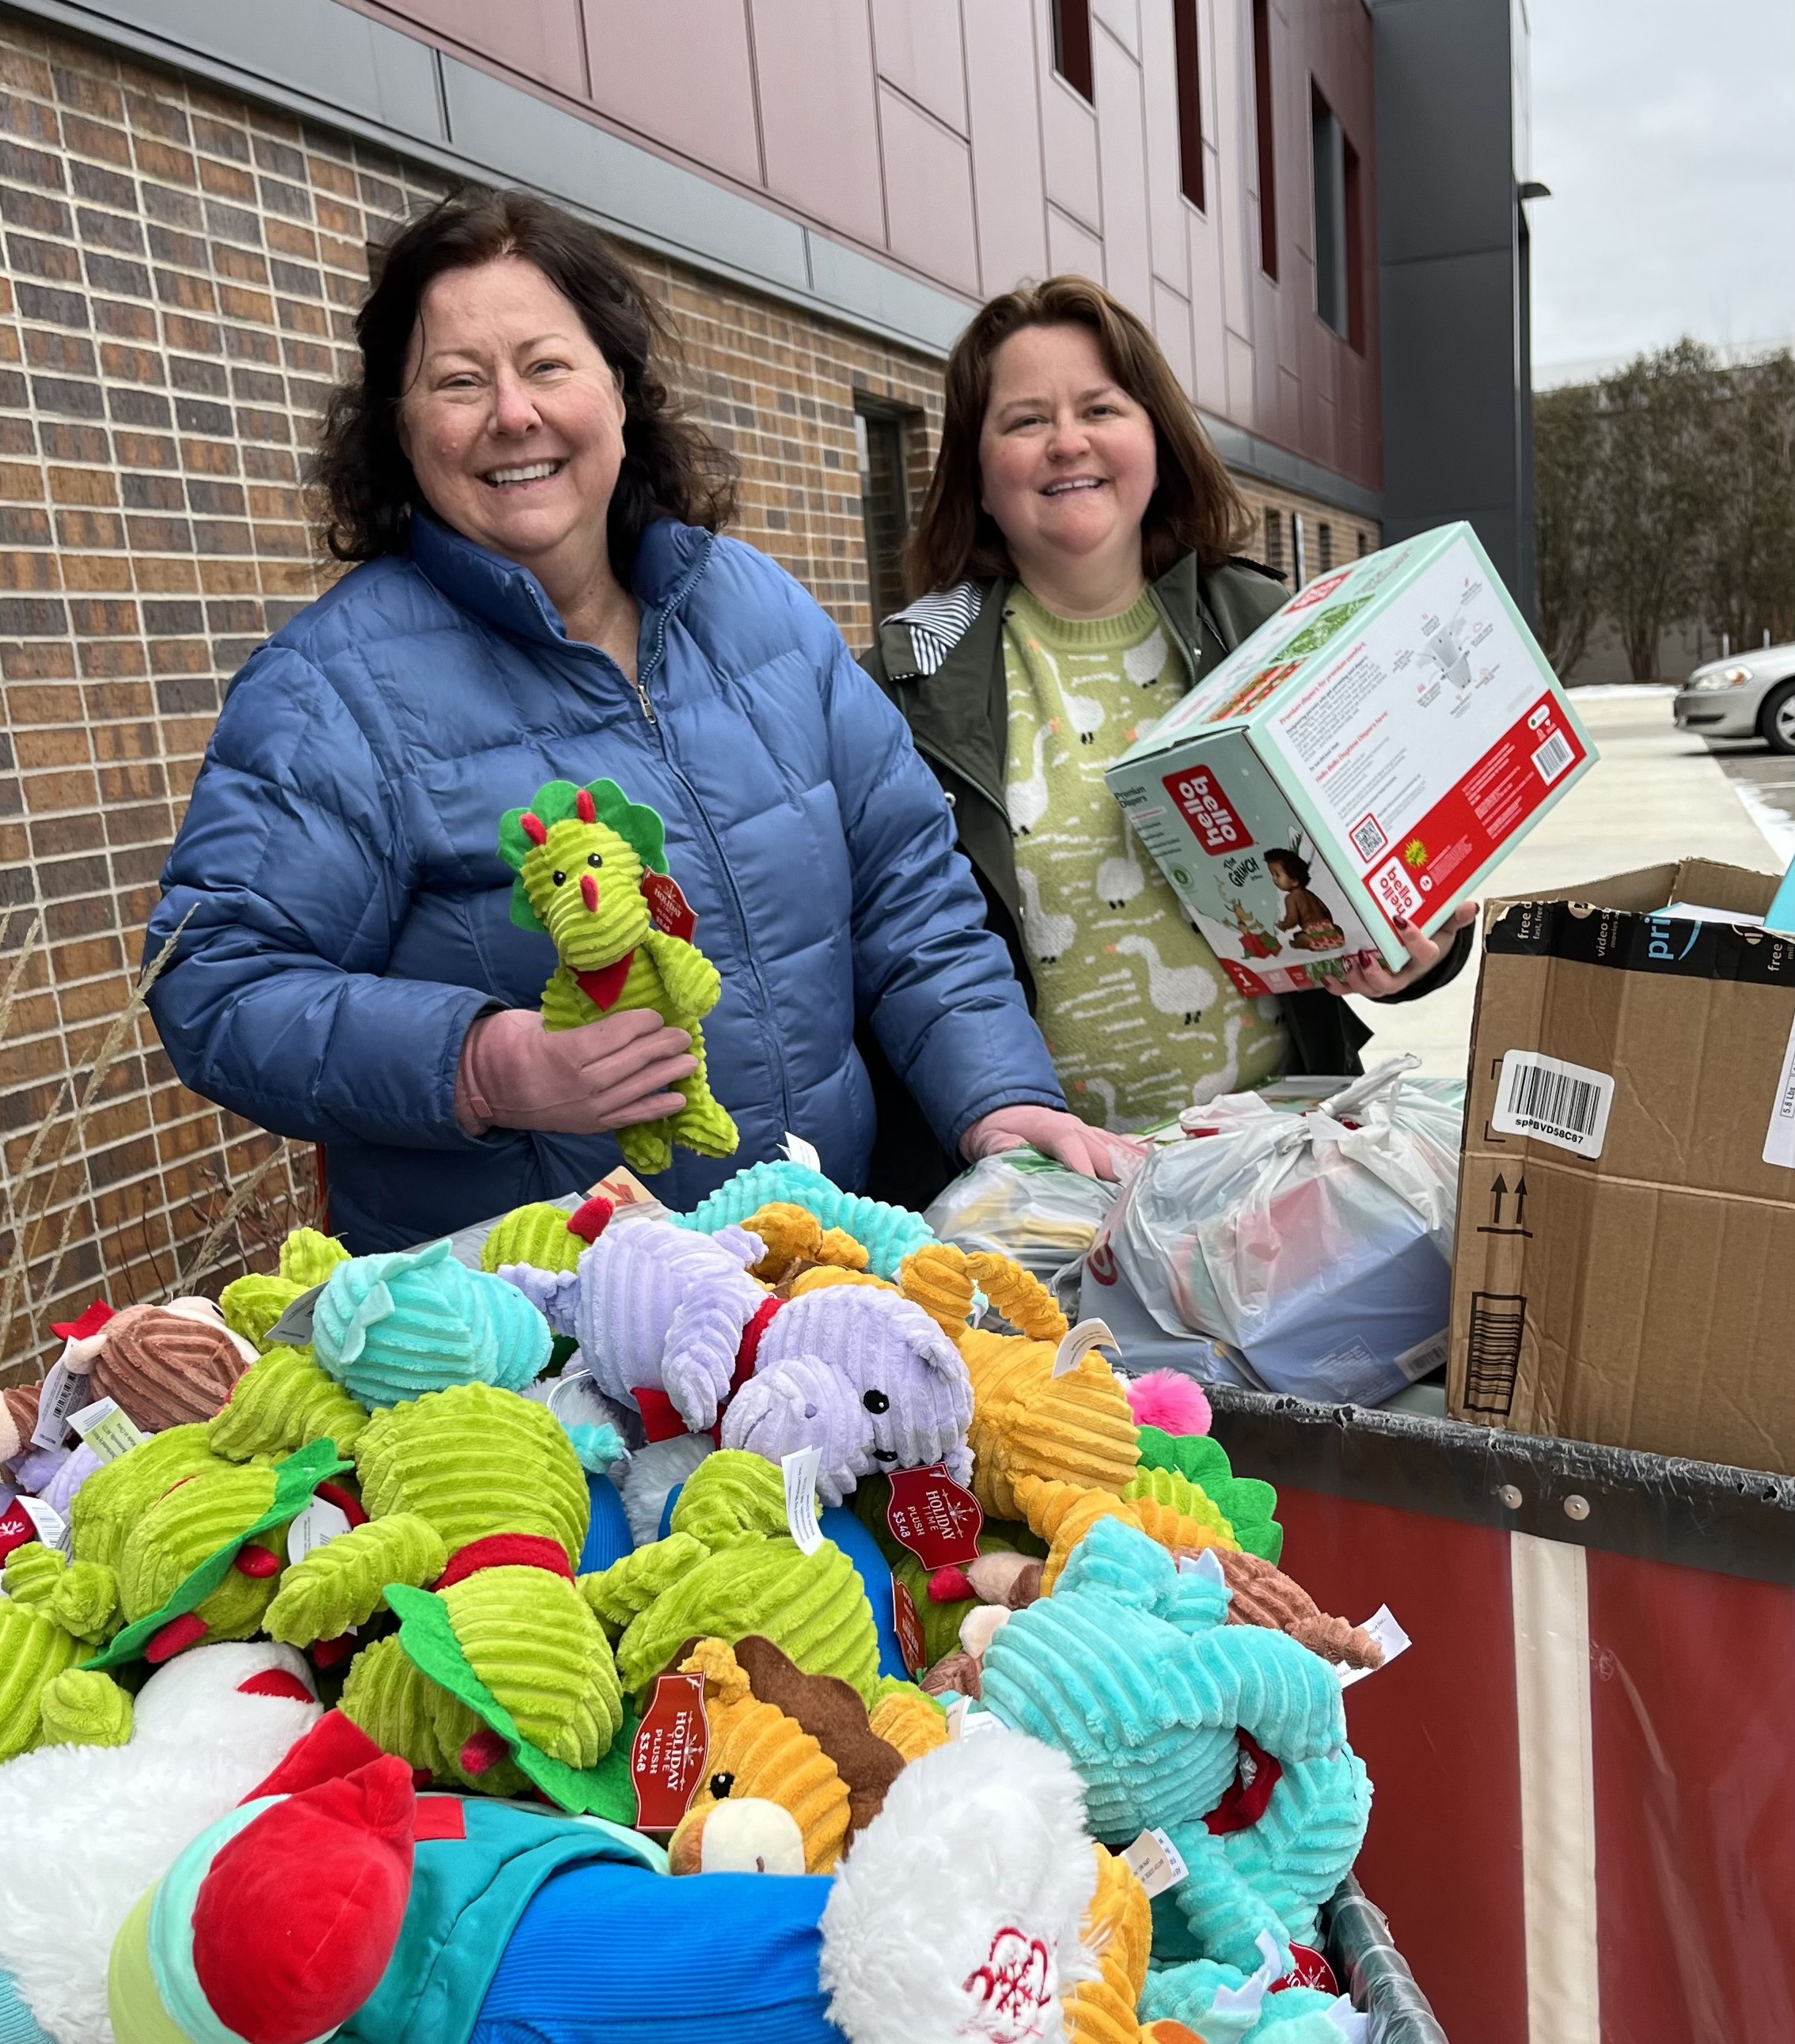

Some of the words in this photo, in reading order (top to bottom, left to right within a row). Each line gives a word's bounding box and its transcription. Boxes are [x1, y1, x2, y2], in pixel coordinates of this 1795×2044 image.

[1114, 786, 1147, 800] Premium
[1120, 795, 1148, 809] Diapers
[1178, 781, 1225, 847] hello
[1190, 776, 1237, 842] bello
[1224, 857, 1237, 871] The
[1228, 856, 1261, 887] GRINCH
[1387, 867, 1413, 908] bello
[655, 888, 682, 918] HOLIDAY
[1534, 906, 1543, 921] free
[1517, 915, 1531, 940] free
[1597, 923, 1610, 957] video
[1610, 920, 1619, 948] movies
[1645, 916, 1675, 960] pri
[1767, 942, 1784, 972] free
[1238, 973, 1252, 988] 1
[1782, 1101, 1793, 1113] 5.8
[892, 1511, 911, 1538] $3.48
[907, 1505, 925, 1536] PLUSH
[922, 1504, 939, 1531] TIME
[925, 1490, 956, 1540] HOLIDAY
[636, 1731, 651, 1773] $3.48
[649, 1727, 664, 1774] PLUSH
[662, 1730, 676, 1772] TIME
[666, 1710, 688, 1792] HOLIDAY
